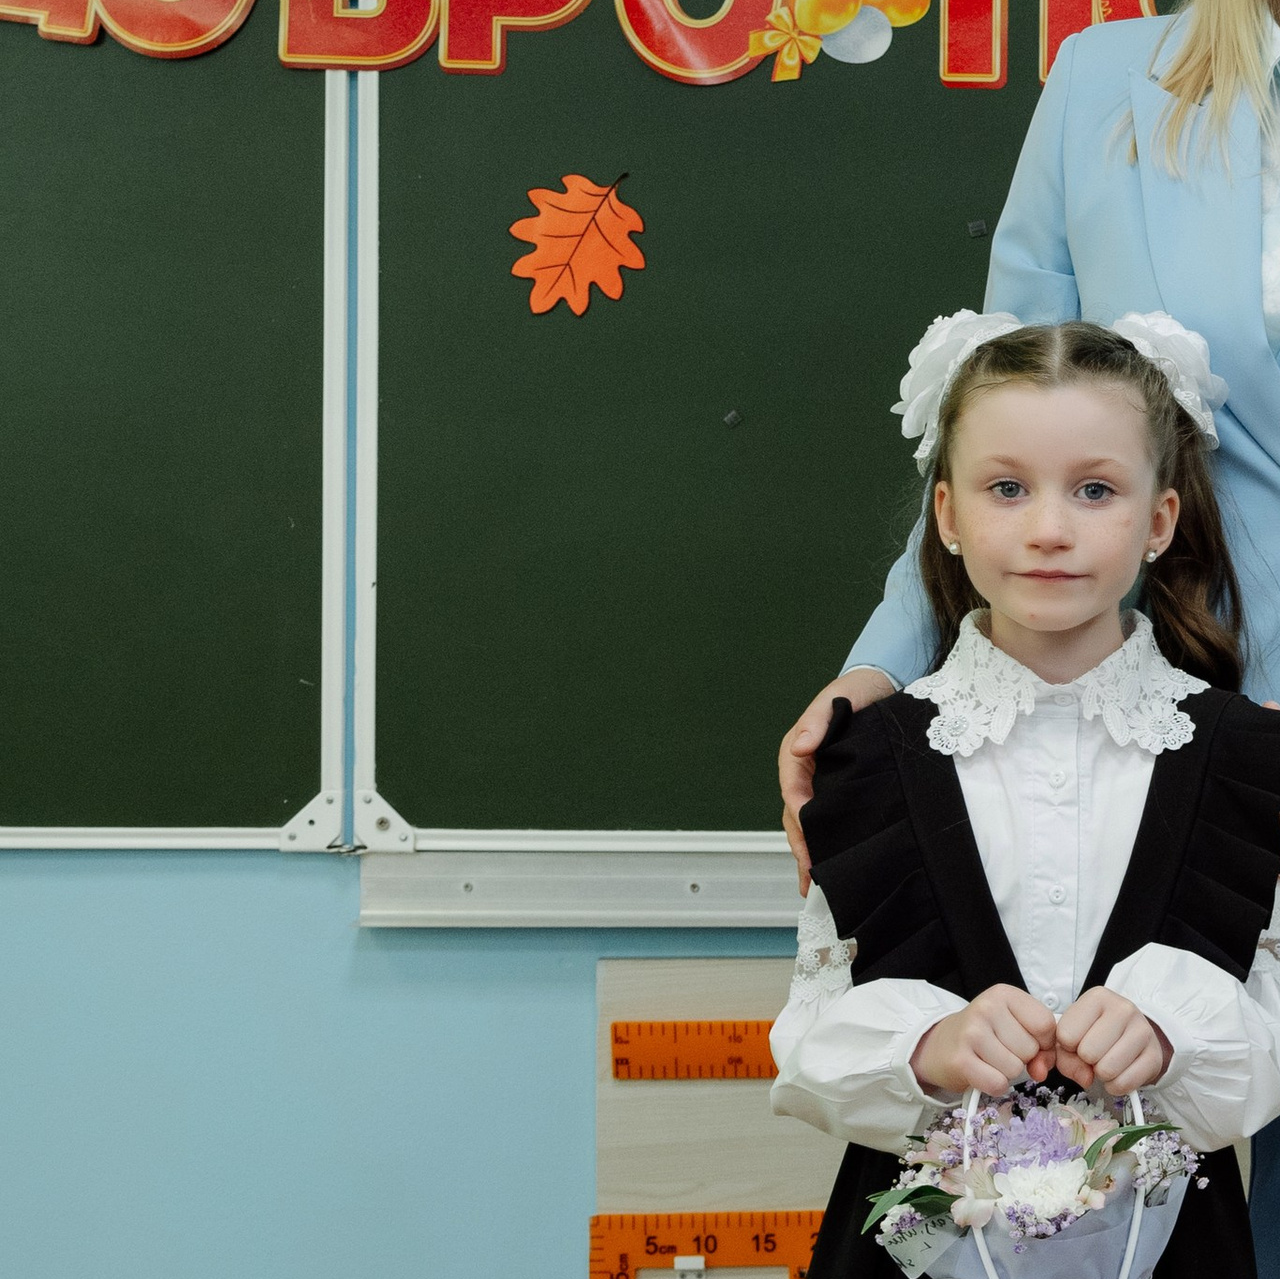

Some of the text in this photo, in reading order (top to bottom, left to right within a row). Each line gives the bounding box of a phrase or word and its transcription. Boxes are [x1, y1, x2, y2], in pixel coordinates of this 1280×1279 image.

[645, 1233, 777, 1255] 5cm 10 15
